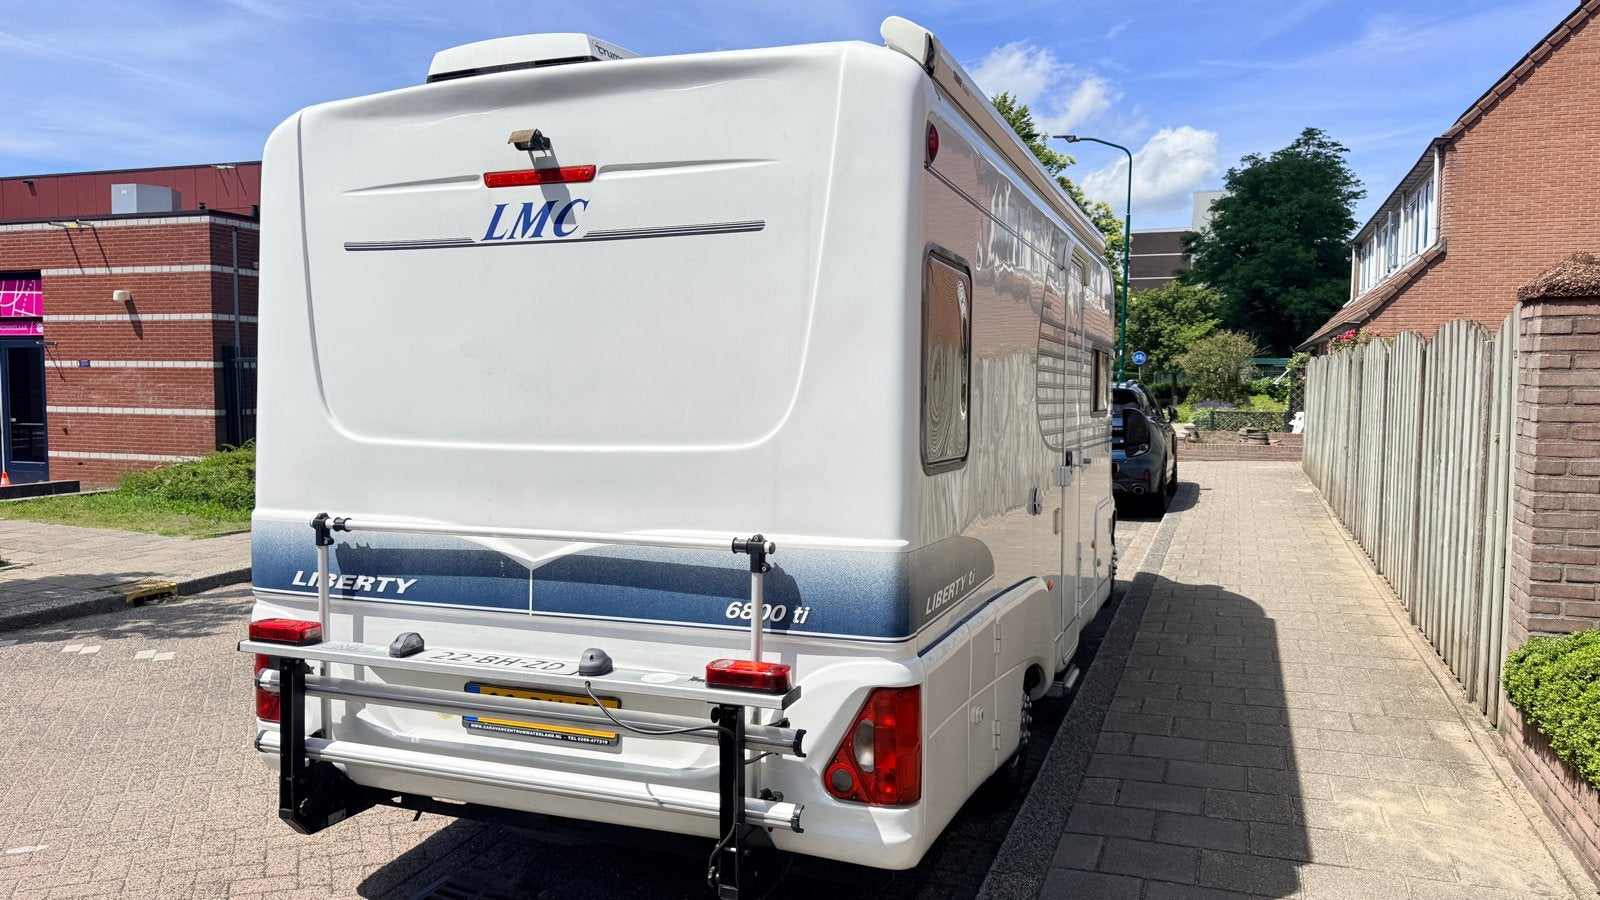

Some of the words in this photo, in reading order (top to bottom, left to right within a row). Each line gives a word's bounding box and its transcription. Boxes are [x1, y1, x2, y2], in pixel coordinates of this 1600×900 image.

[481, 198, 590, 241] LMC
[291, 570, 418, 594] LIBERTY
[925, 573, 967, 616] LIBERTY
[725, 601, 787, 622] 6800
[792, 606, 811, 624] ti
[430, 651, 566, 671] 22-BH-ZD
